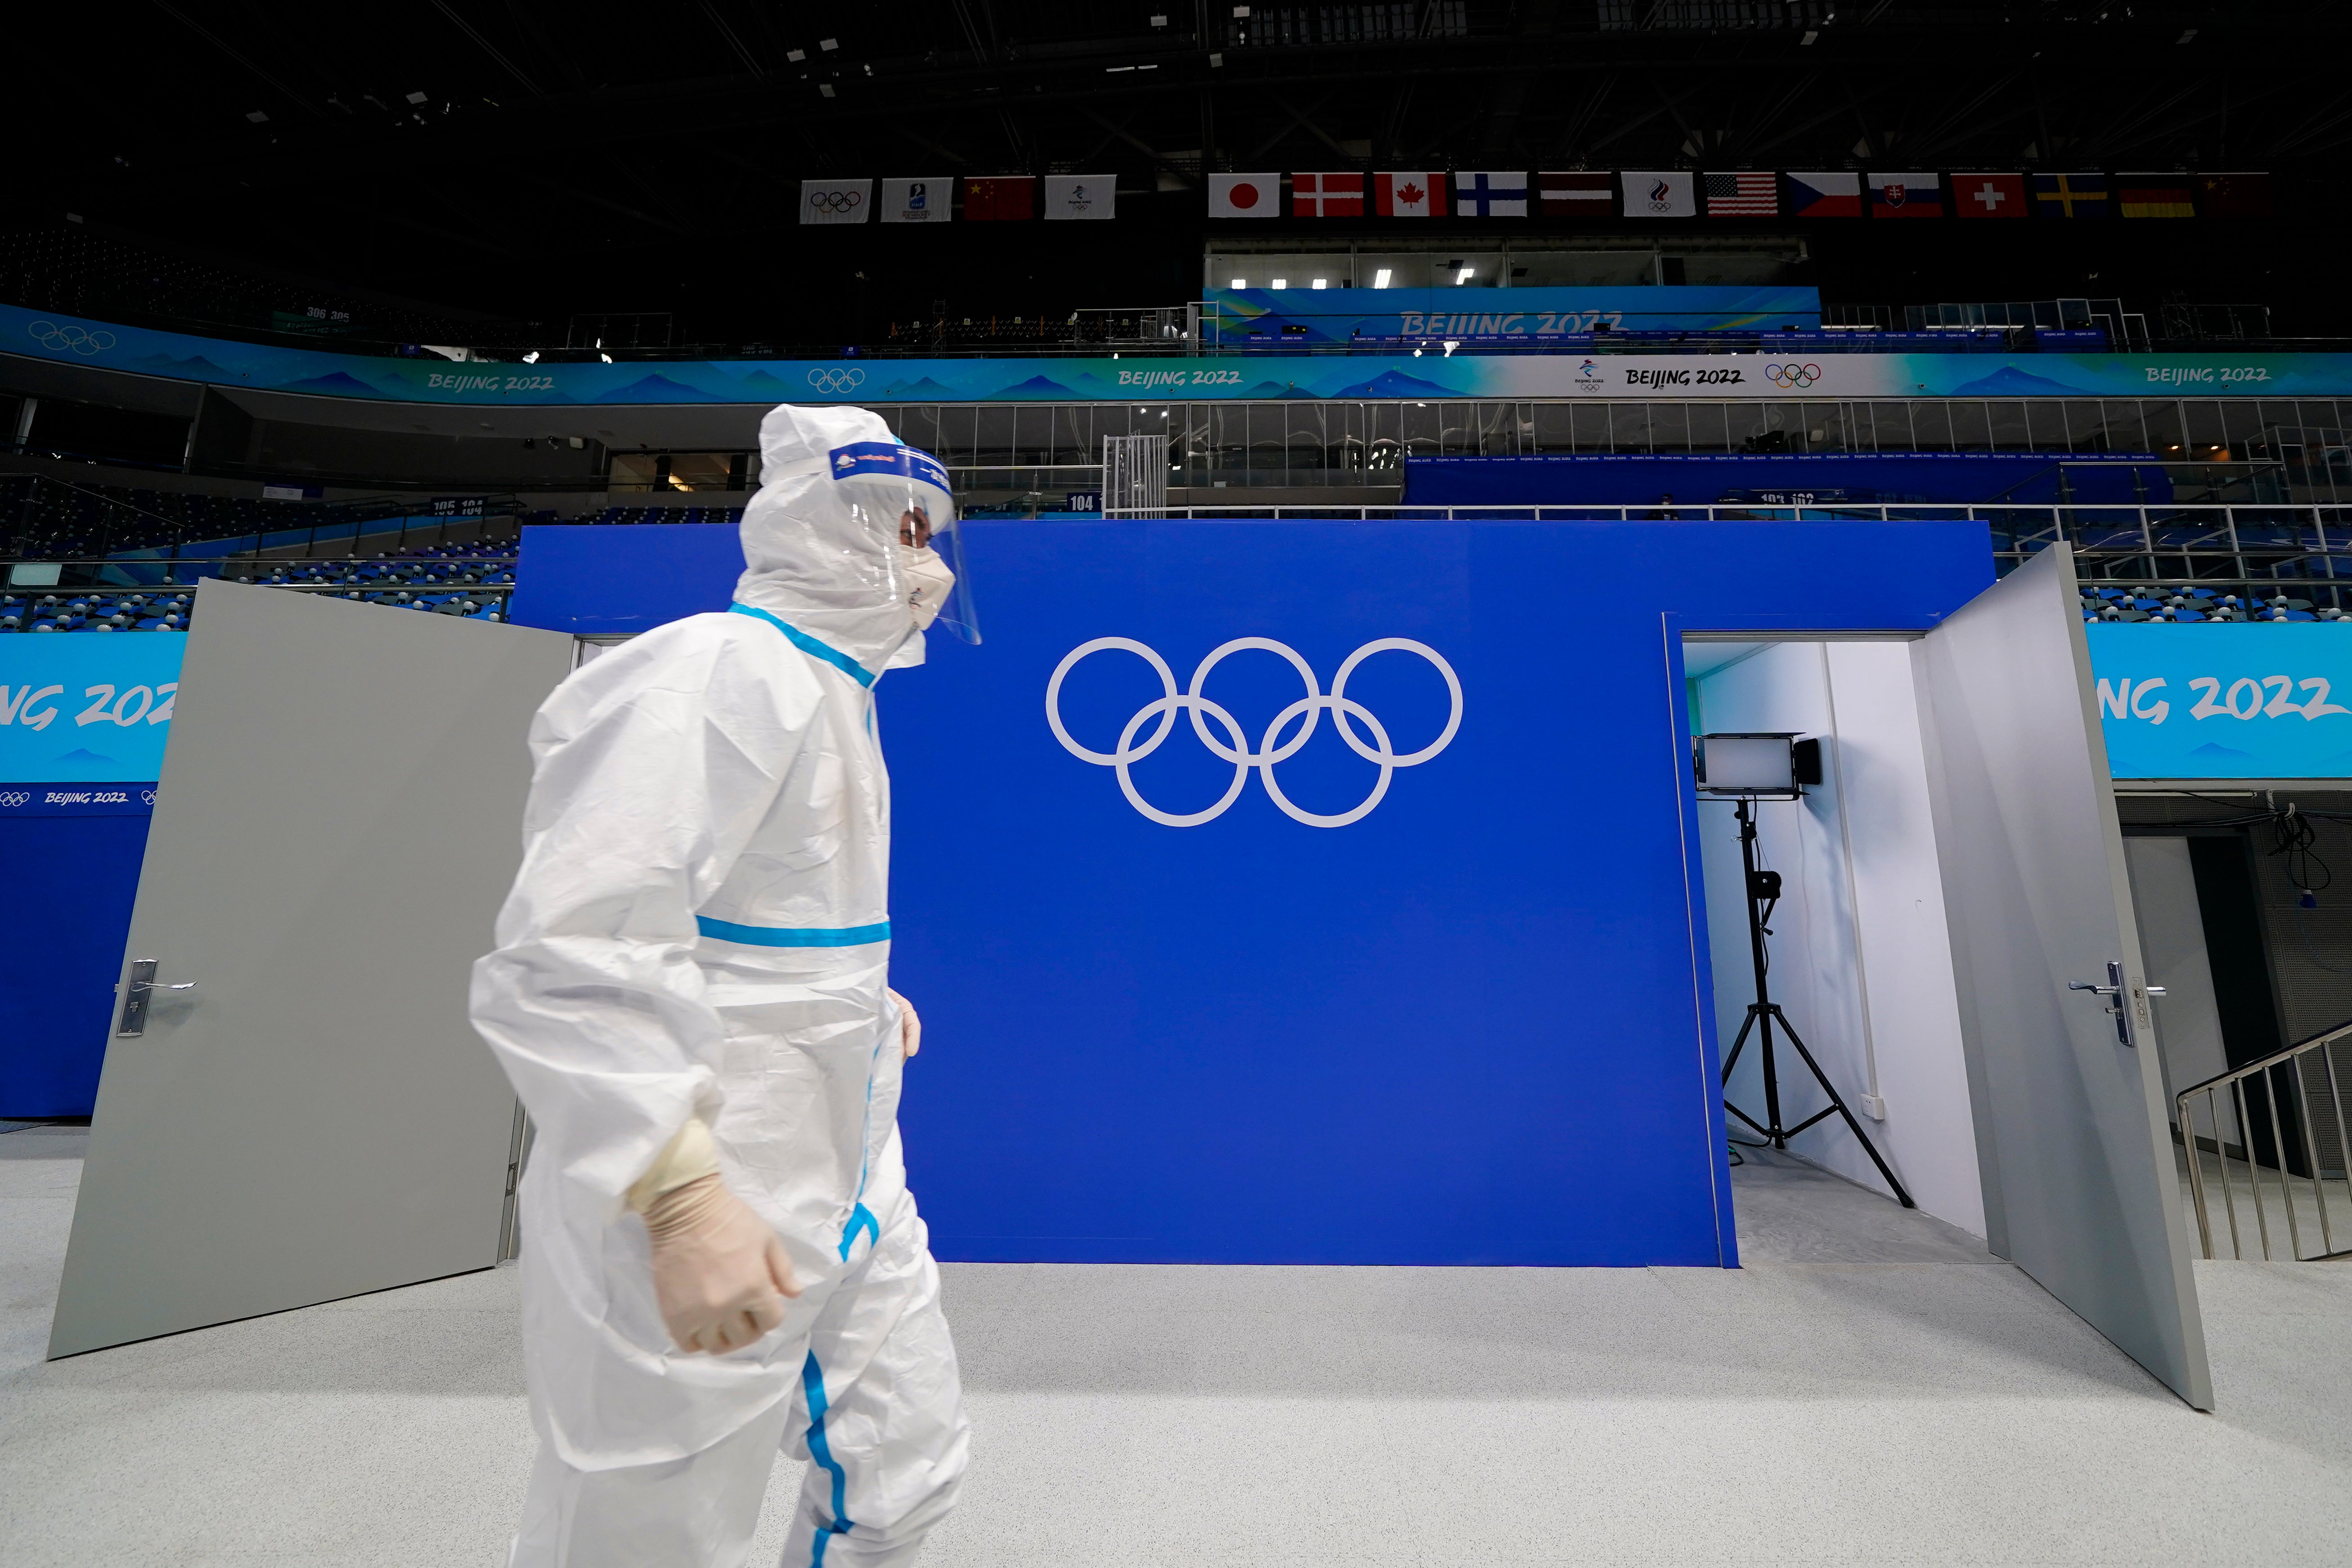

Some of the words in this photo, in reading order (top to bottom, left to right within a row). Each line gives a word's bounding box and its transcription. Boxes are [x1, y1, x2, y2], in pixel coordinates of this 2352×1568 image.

[307, 307, 327, 319] 306
[331, 311, 350, 323] 305
[1400, 310, 1524, 334] BEIJING
[1535, 309, 1630, 334] 2022
[427, 373, 500, 393] BEIJING
[504, 376, 556, 391] 2022
[1118, 371, 1186, 389] BEIJING
[1191, 370, 1244, 385] 2022
[1625, 369, 1690, 389] BEIJING
[1696, 369, 1746, 384] 2022
[2145, 367, 2214, 386] BEIJING
[2220, 367, 2272, 382] 2022
[461, 499, 483, 516] 104
[1070, 495, 1093, 511] 104
[2188, 675, 2352, 721] 2022
[45, 792, 92, 806] BEIJING
[93, 792, 130, 803] 2022
